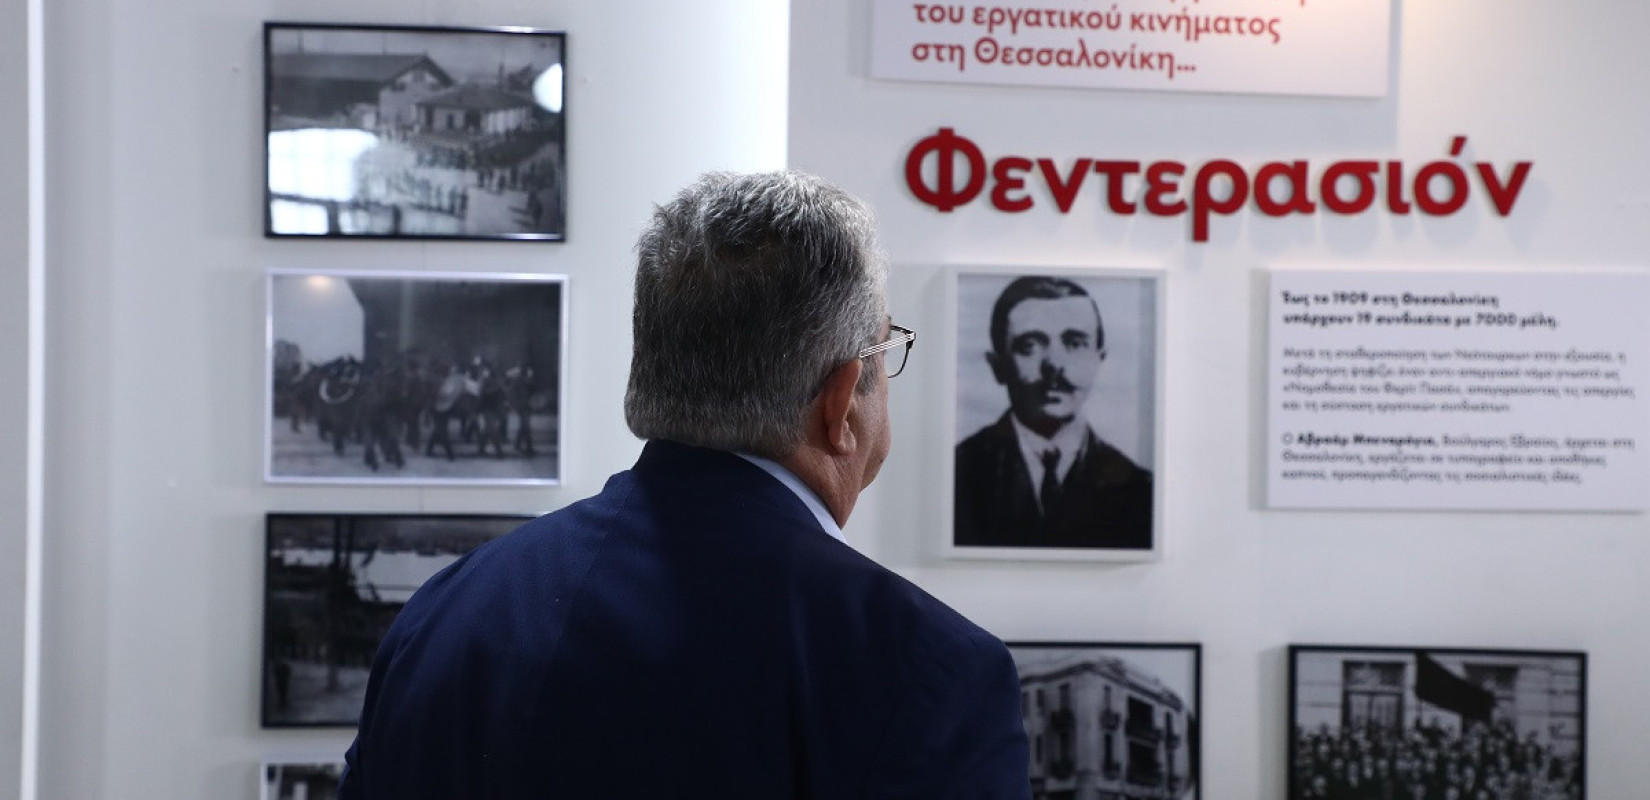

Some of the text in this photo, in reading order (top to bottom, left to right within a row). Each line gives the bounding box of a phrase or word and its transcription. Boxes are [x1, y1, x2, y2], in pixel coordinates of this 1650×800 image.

[913, 3, 1281, 43] του εργατικού κινήματος
[911, 43, 965, 71] στη
[904, 127, 1533, 243] Φεντερασιόν
